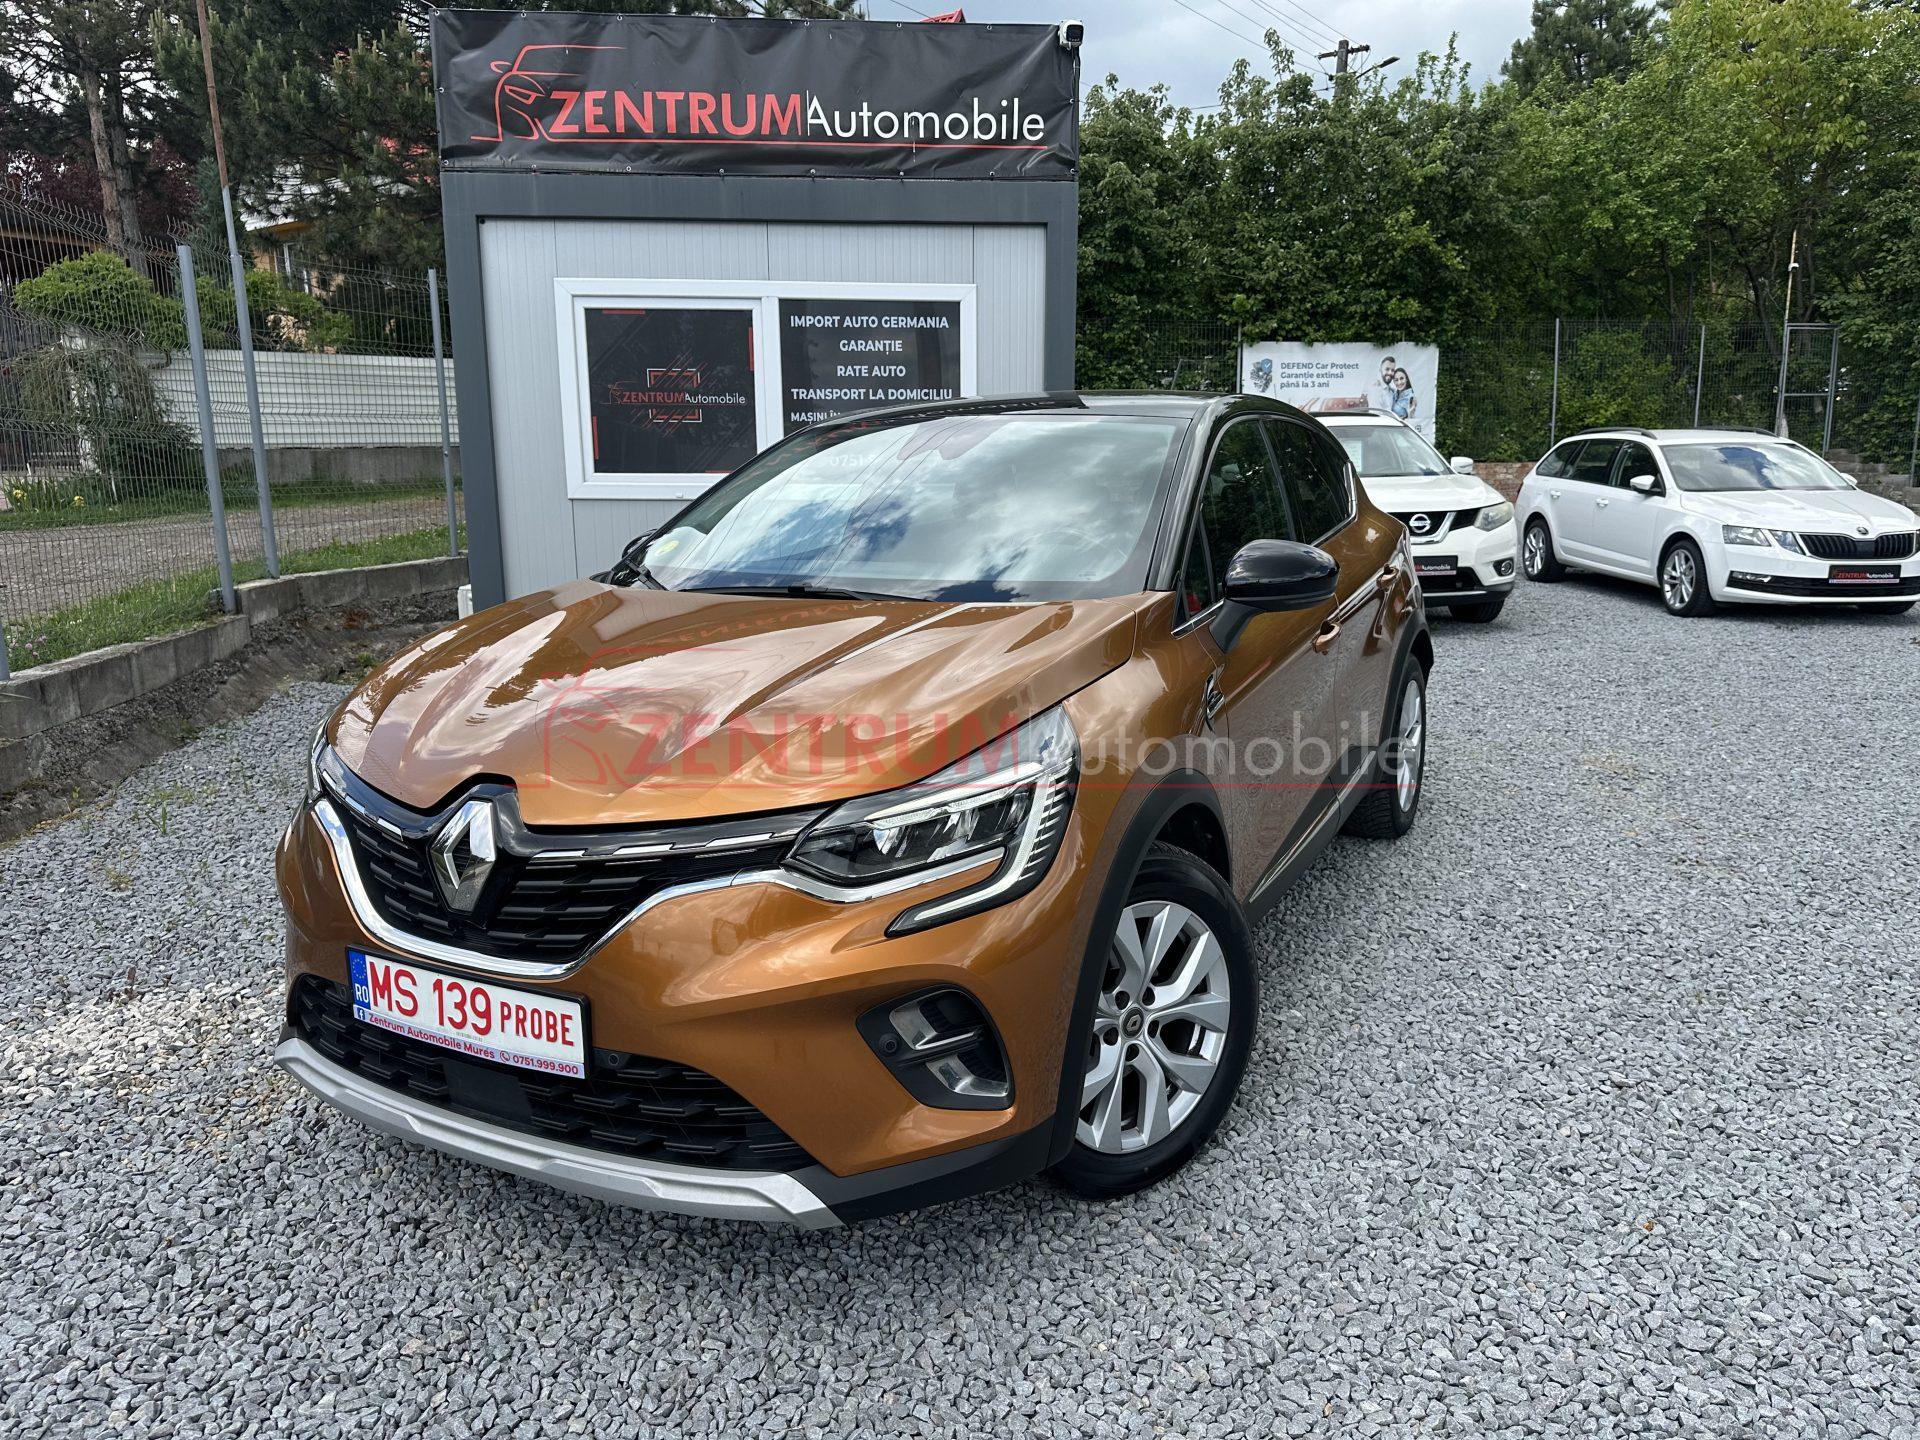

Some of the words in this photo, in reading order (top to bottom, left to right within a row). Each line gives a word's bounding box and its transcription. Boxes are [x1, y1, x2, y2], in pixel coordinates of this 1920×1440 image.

[547, 90, 801, 135] ZENTRUM
[807, 90, 1045, 141] Automobile
[790, 315, 840, 328] IMPORT
[843, 316, 878, 328] AUTO
[882, 316, 949, 329] GERMANIA
[839, 340, 903, 355] GARANȚIE
[837, 365, 868, 377] RATE
[872, 365, 906, 377] AUTO
[1280, 362, 1314, 370] DEFEND
[1315, 362, 1329, 370] Car
[1330, 362, 1360, 370] Protect
[1301, 380, 1309, 388] la
[1310, 380, 1316, 388] 3
[1317, 380, 1330, 388] ani
[622, 391, 685, 404] ZENTRUM
[685, 391, 746, 404] Automobile
[791, 388, 866, 400] TRANSPORT
[869, 388, 884, 400] LA
[888, 388, 953, 400] DOMICILIU
[354, 983, 369, 1004] RO
[369, 961, 418, 1018] MS
[432, 978, 493, 1036] 139
[500, 1000, 575, 1047] PROBE
[368, 1012, 405, 1034] Zentrum
[407, 1026, 462, 1050] Automobile
[463, 1041, 495, 1059] Mures
[512, 1054, 579, 1075] 0751.999.900
